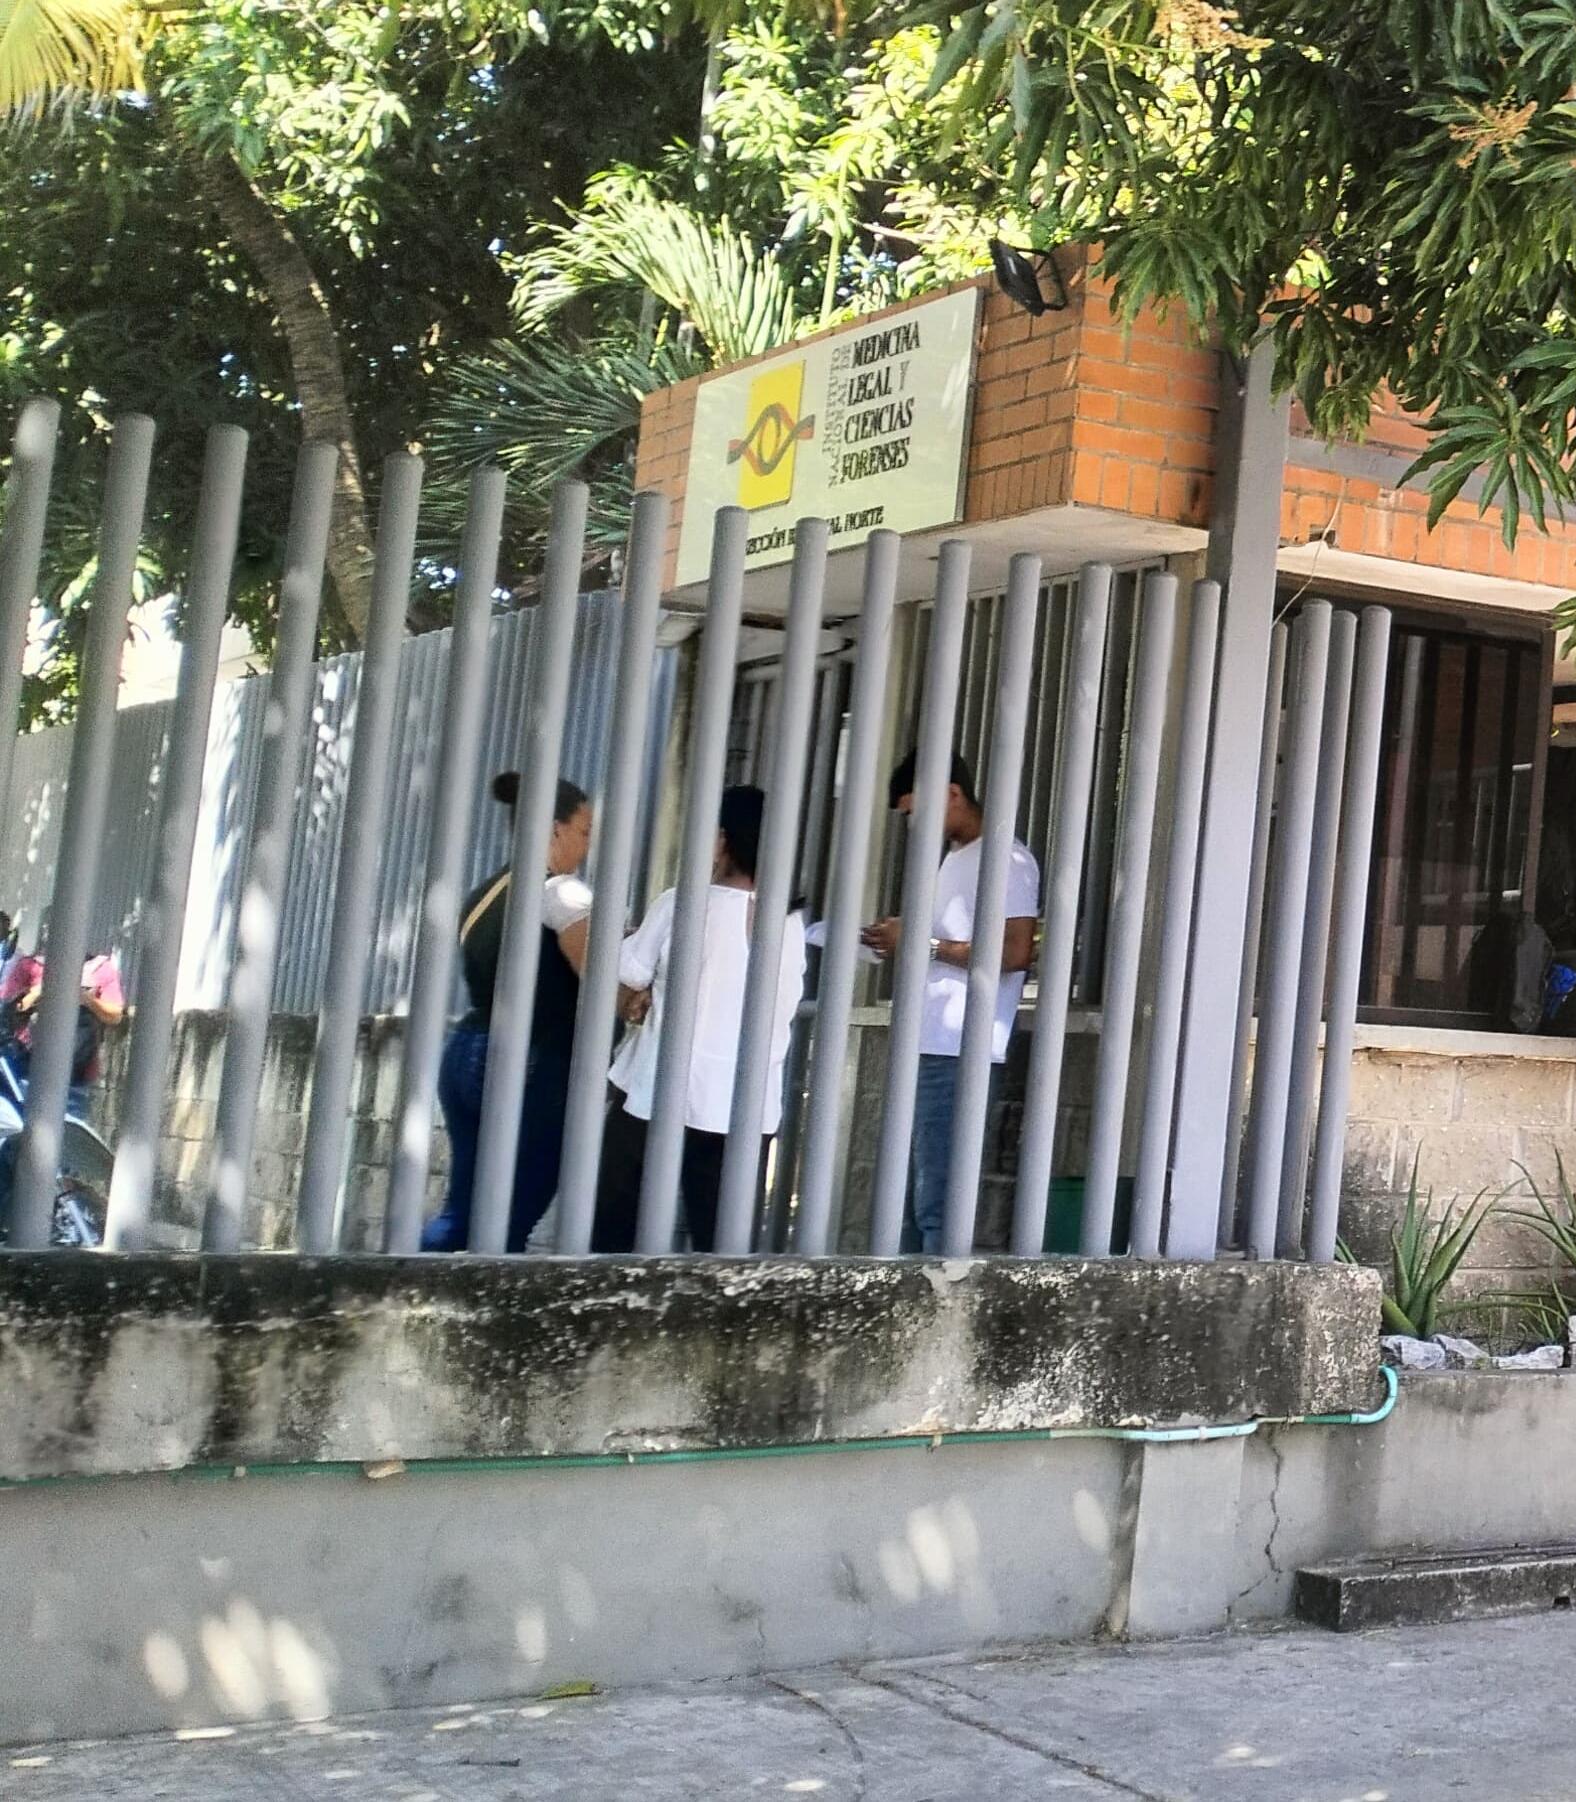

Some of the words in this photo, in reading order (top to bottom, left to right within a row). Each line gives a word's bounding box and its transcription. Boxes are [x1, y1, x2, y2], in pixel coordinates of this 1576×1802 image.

[852, 320, 920, 369] MEDICINA
[847, 366, 892, 407] LEGAL
[899, 360, 910, 391] Y
[844, 397, 915, 445] CIENCIAS
[839, 437, 910, 484] FORENSES
[844, 505, 884, 532] NORTE
